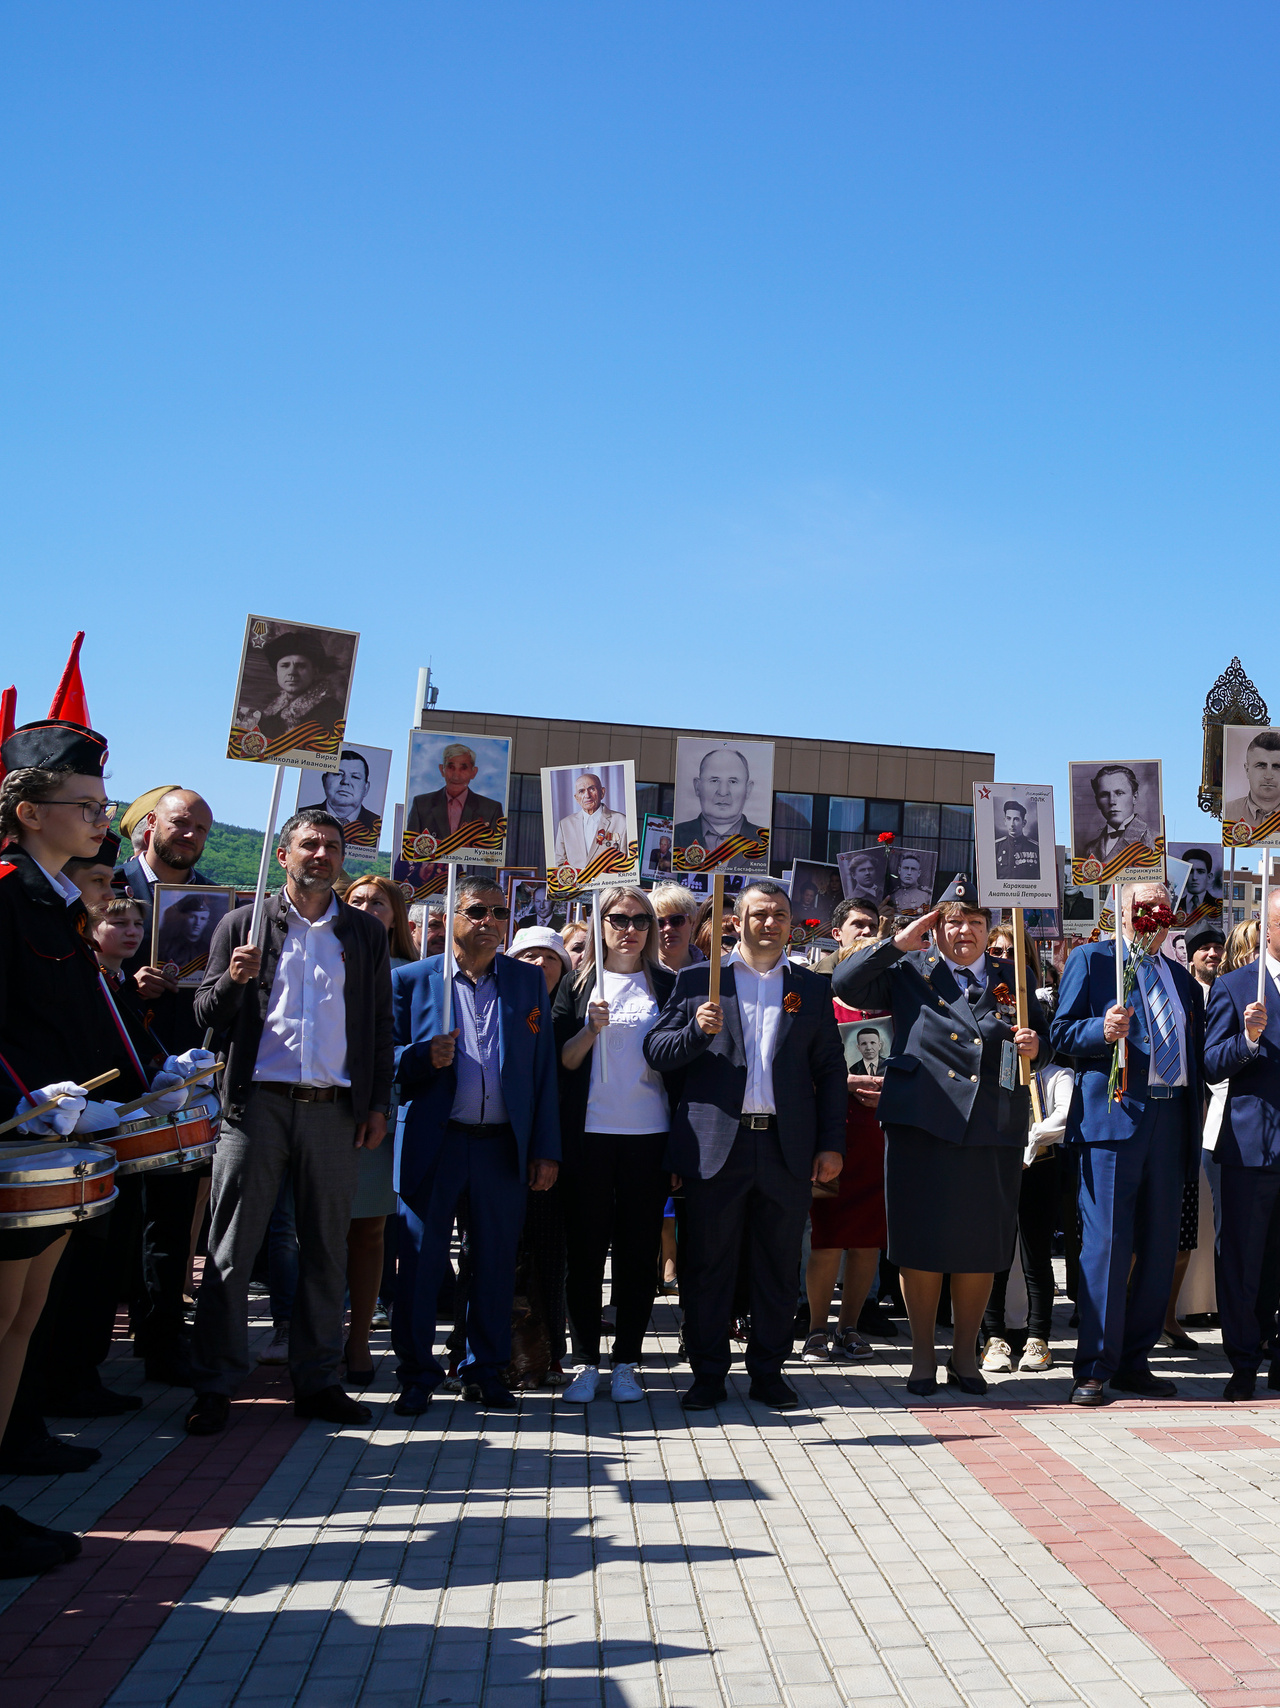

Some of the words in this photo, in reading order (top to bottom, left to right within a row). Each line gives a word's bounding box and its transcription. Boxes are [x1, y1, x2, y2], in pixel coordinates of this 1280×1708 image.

[315, 752, 338, 761] Вирко
[268, 755, 299, 765] Николай
[301, 759, 337, 770] Иванович
[348, 852, 376, 860] Карпович
[474, 849, 503, 857] Кузьмин
[464, 855, 503, 863] Демьянович
[1003, 882, 1037, 890] Каракашев
